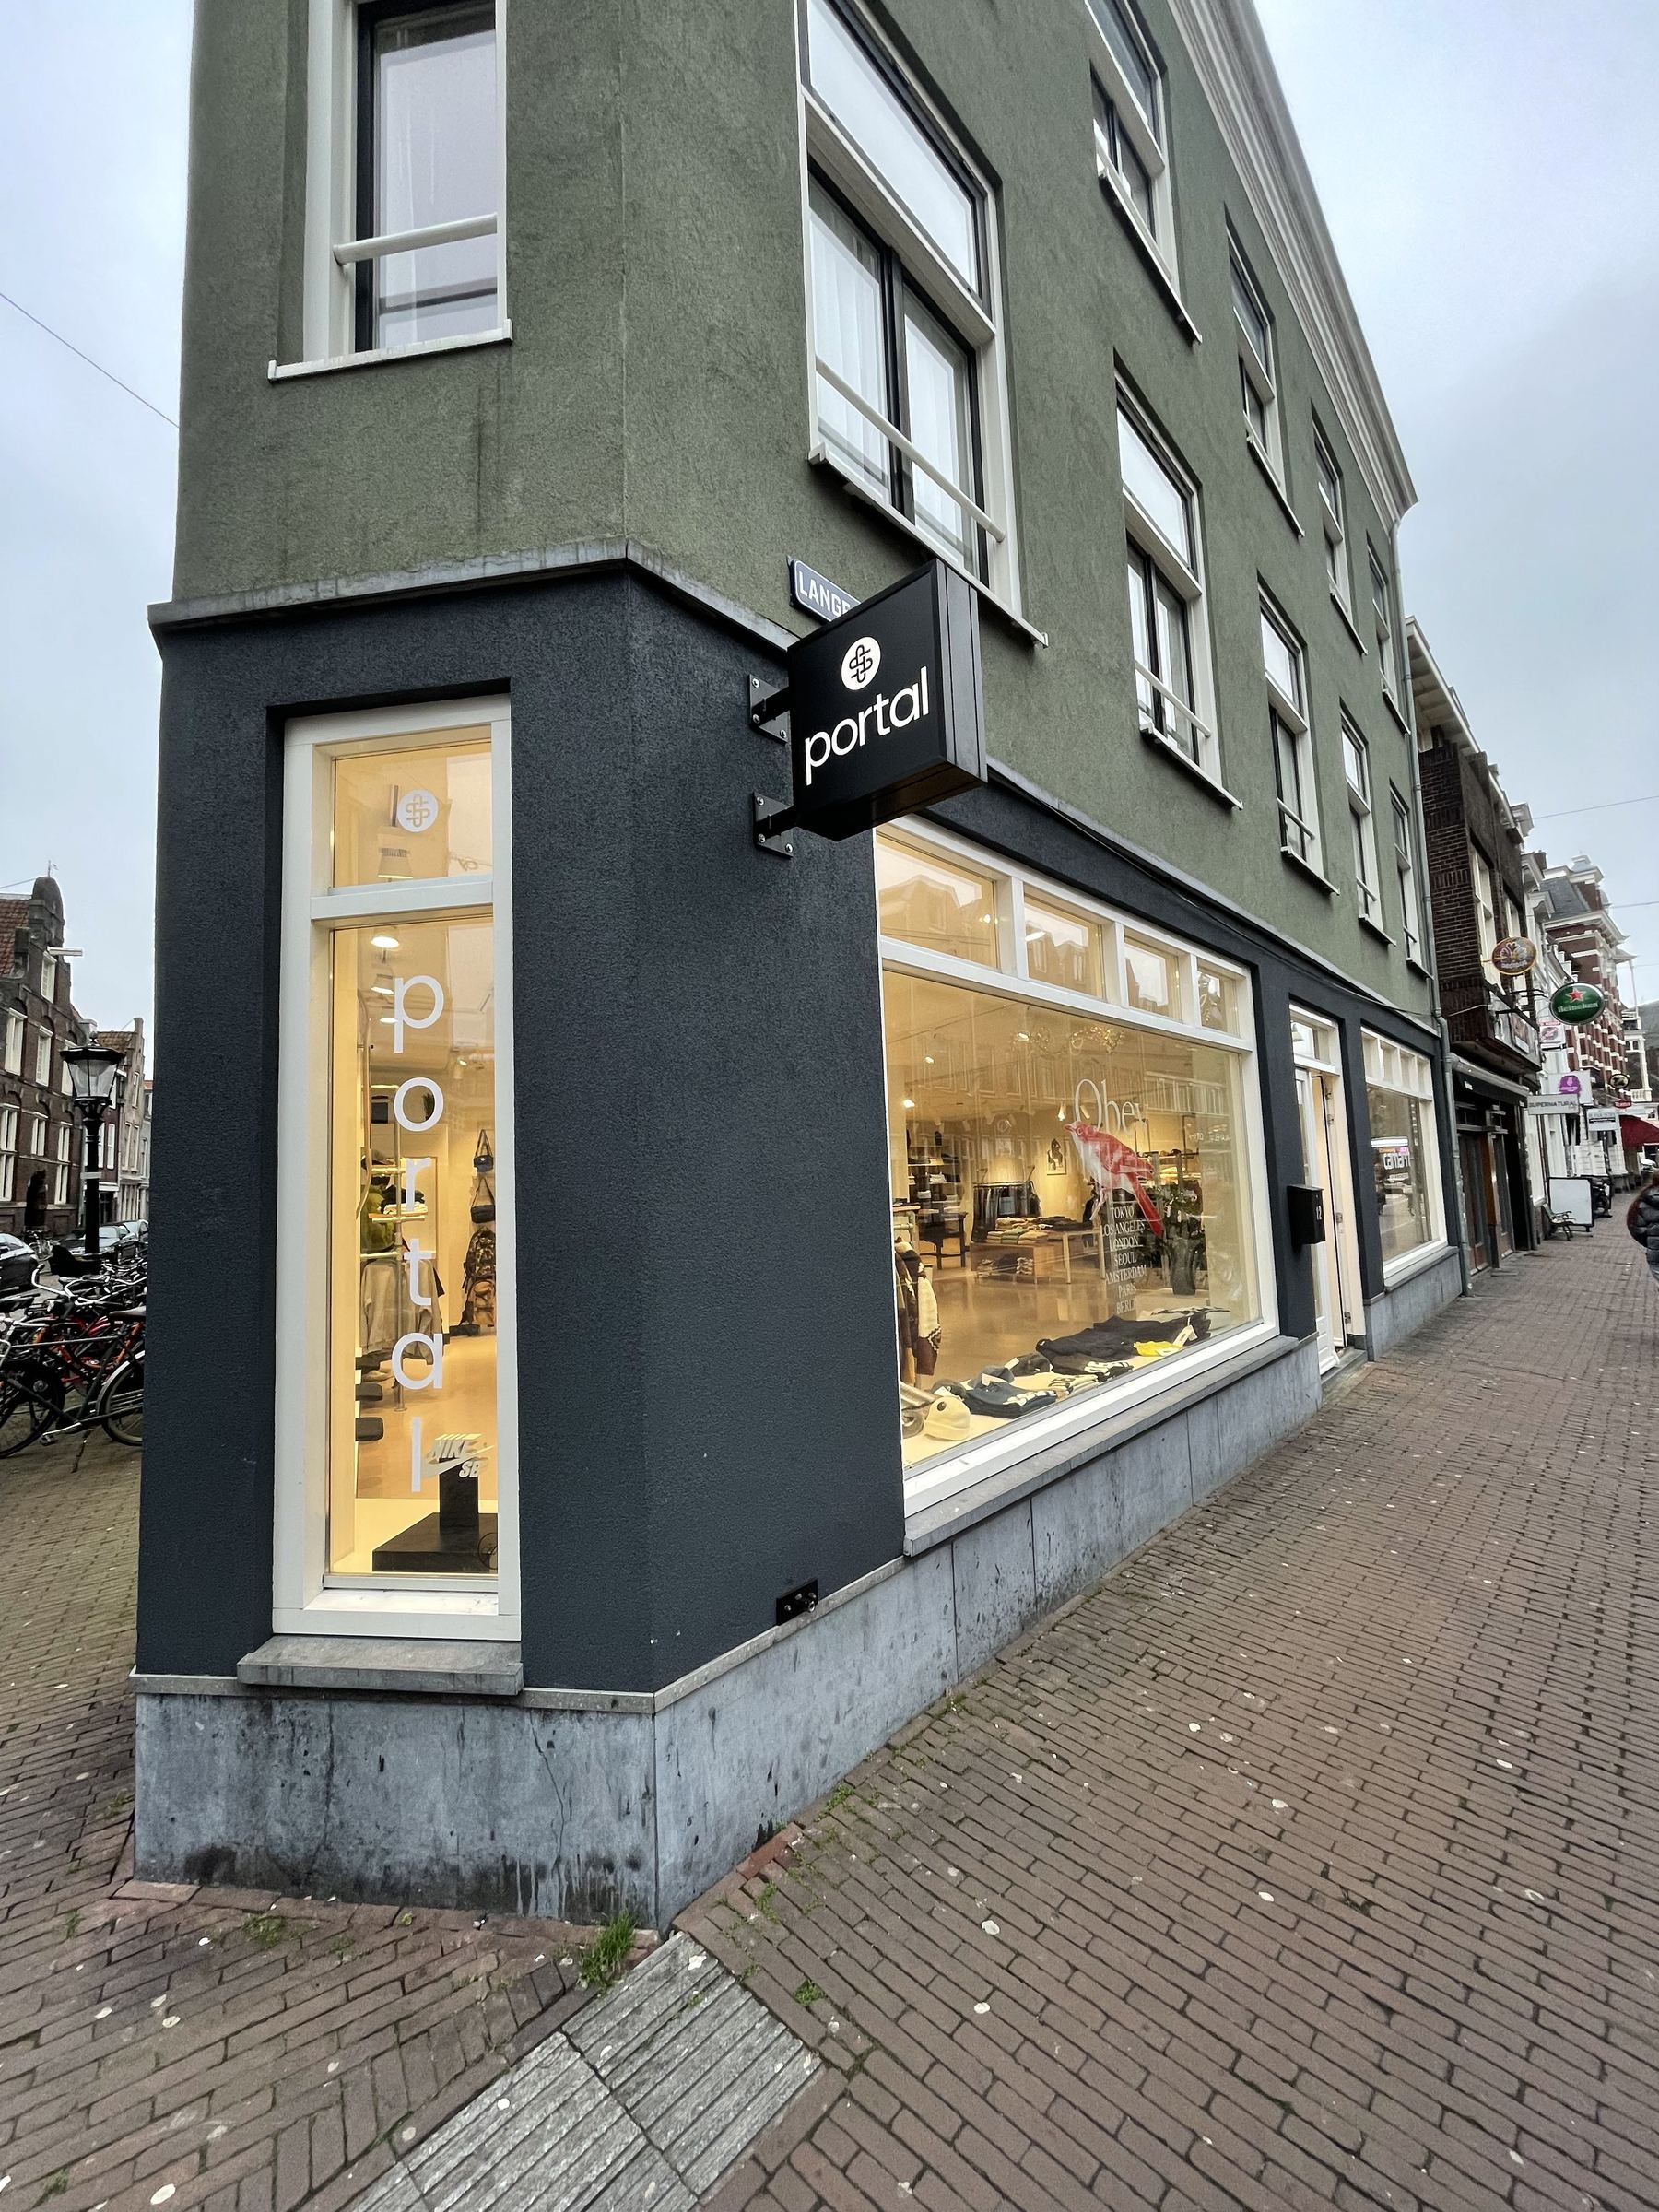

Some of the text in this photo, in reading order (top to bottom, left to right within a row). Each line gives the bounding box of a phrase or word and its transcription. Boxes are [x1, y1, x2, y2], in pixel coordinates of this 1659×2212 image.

[805, 665, 929, 786] portal
[1558, 1002, 1599, 1013] Heineken
[1110, 1205, 1135, 1219] TOKYO
[1315, 1205, 1323, 1221] 12
[1114, 1218, 1146, 1236] ANGELES
[1109, 1235, 1141, 1253] LONDON
[1113, 1252, 1137, 1267] SEOUL
[1106, 1264, 1147, 1285] AMSTERDAM
[1118, 1282, 1137, 1299] PARIS
[1116, 1299, 1136, 1315] BERLI
[428, 1434, 481, 1464] NIKE
[459, 1458, 488, 1478] SB
